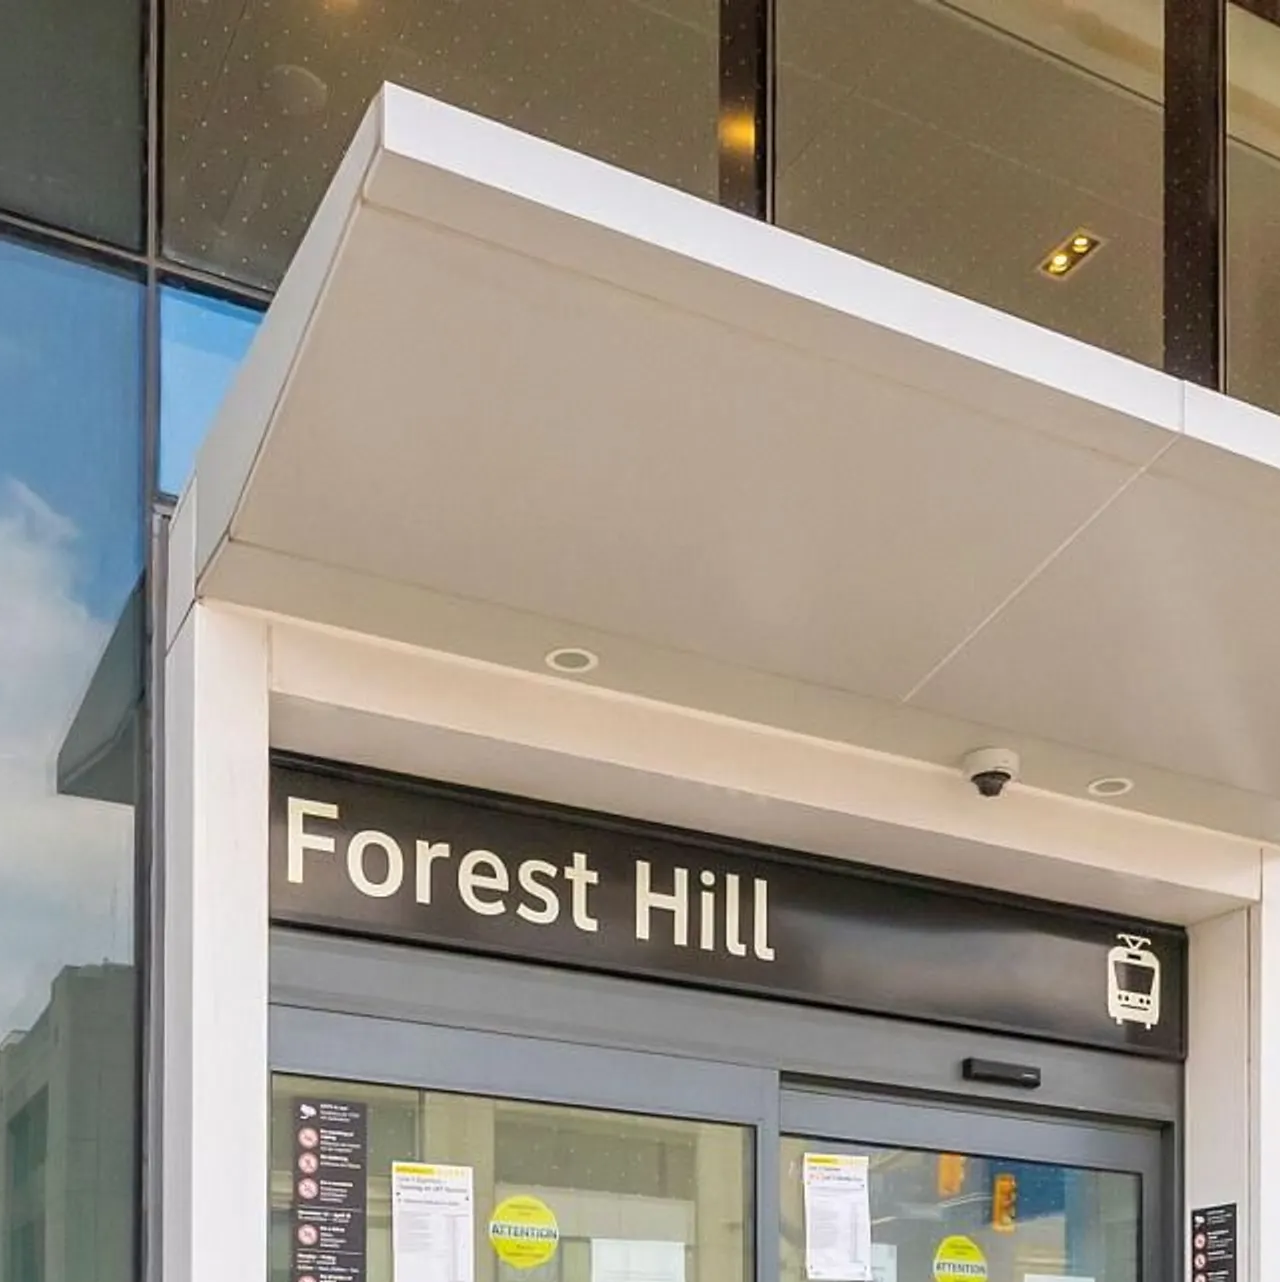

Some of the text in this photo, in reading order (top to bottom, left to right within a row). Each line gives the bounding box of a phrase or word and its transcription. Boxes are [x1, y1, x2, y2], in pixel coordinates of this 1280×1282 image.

[287, 796, 775, 962] Forest Hill
[491, 1223, 557, 1240] ATTENTION
[936, 1262, 986, 1275] ATTENTION
